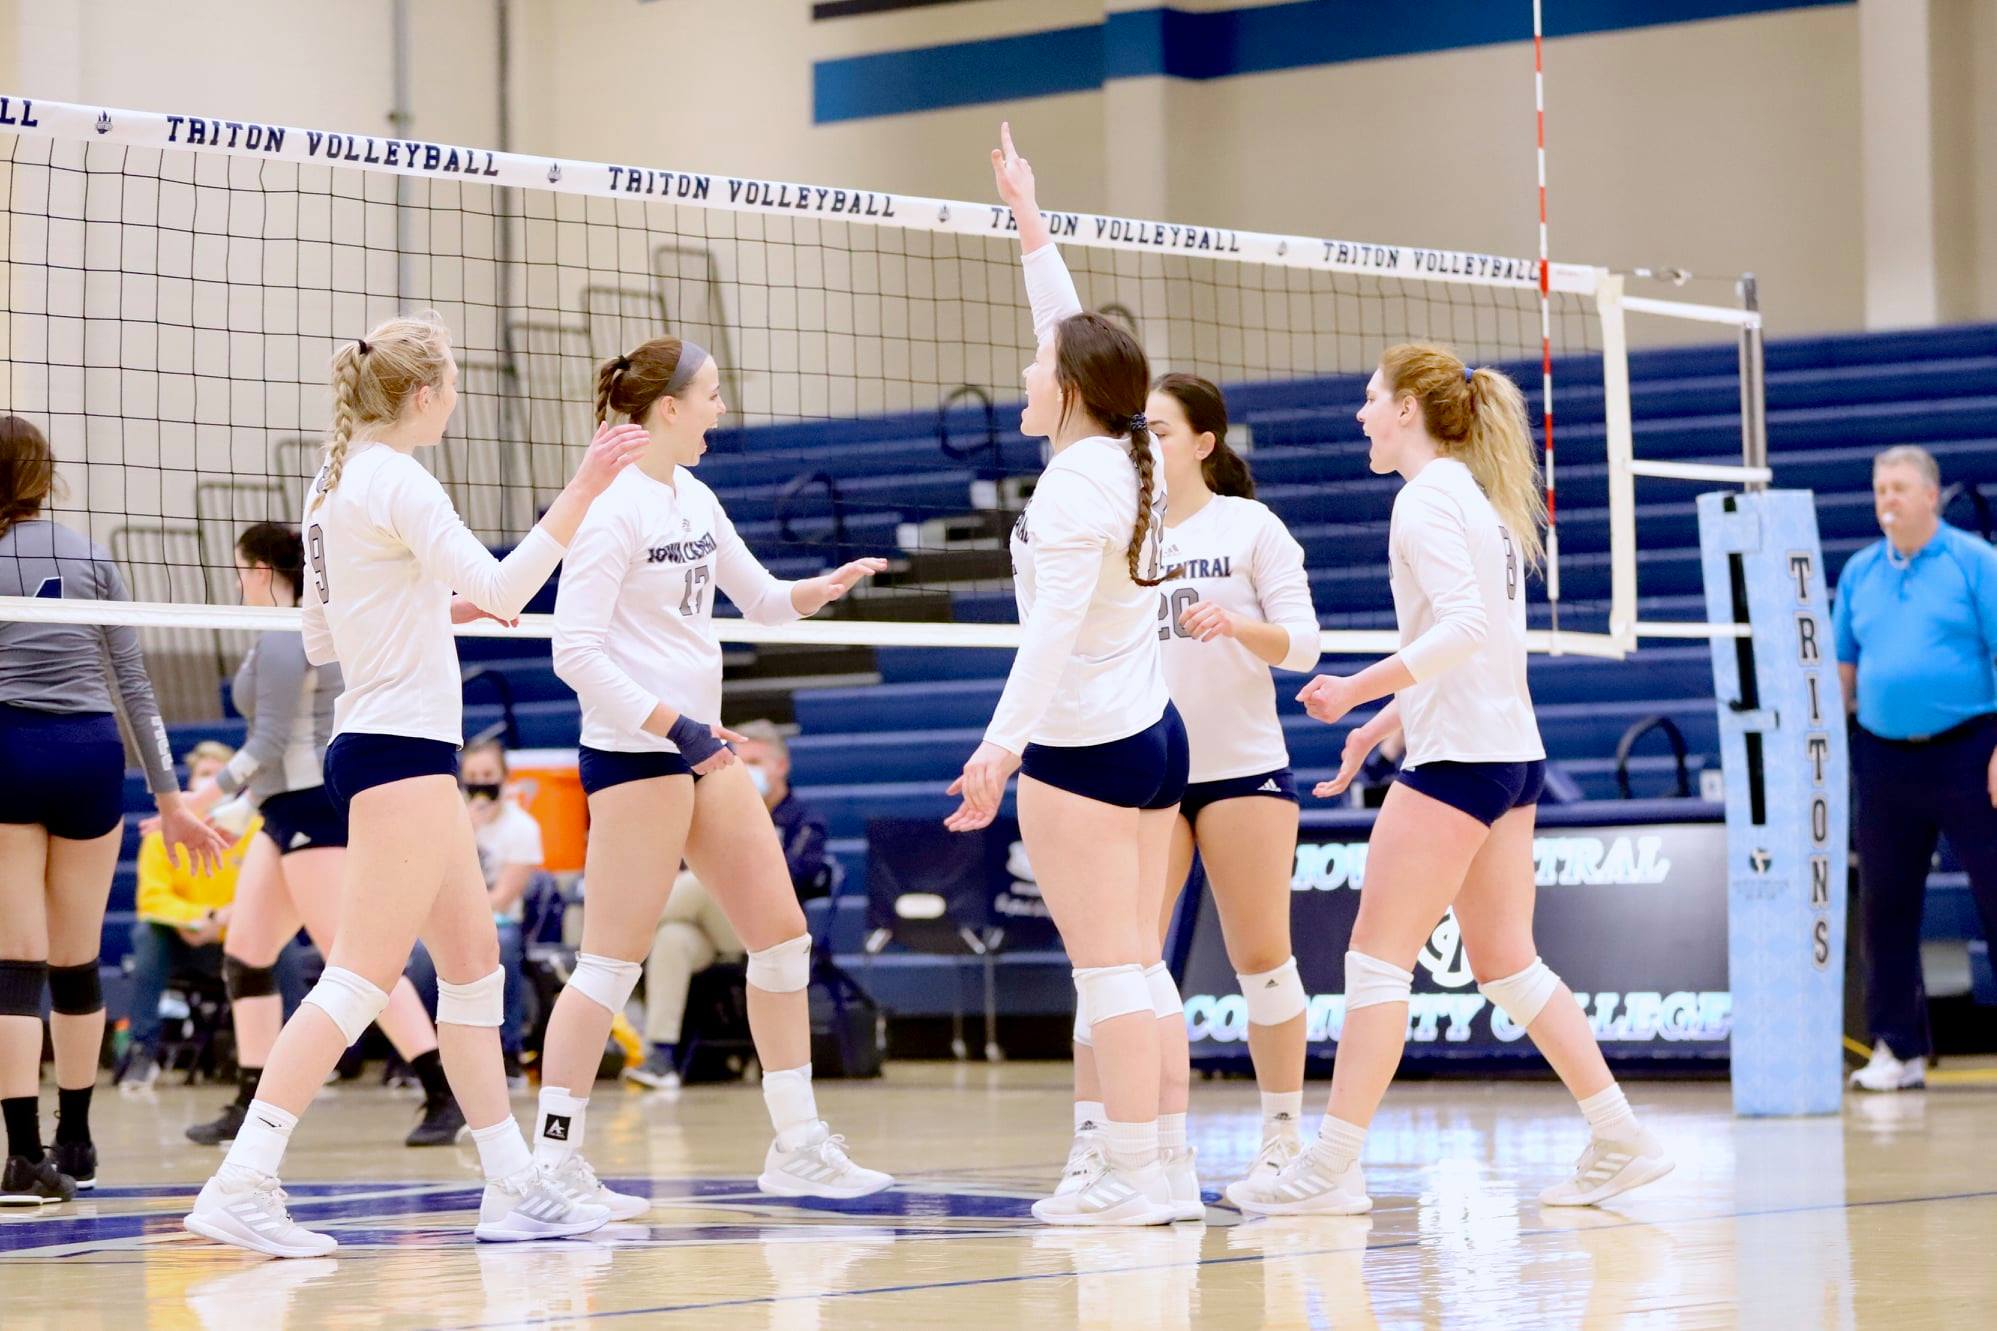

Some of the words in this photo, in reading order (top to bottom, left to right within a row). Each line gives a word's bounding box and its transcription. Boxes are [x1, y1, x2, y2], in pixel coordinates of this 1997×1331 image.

[167, 115, 286, 154] TRITON
[307, 130, 499, 177] VOLLEYBALL
[608, 166, 711, 201] TRITON
[728, 179, 896, 217] VOLLEYBALL
[991, 207, 1078, 236] TRON
[1095, 217, 1242, 254] VOLLEYBALL
[1322, 242, 1399, 269] TRITON
[1413, 251, 1540, 281] VOLLEYBALL
[308, 523, 329, 604] 9
[679, 564, 710, 617] 17
[1787, 552, 1832, 971] TRITONS
